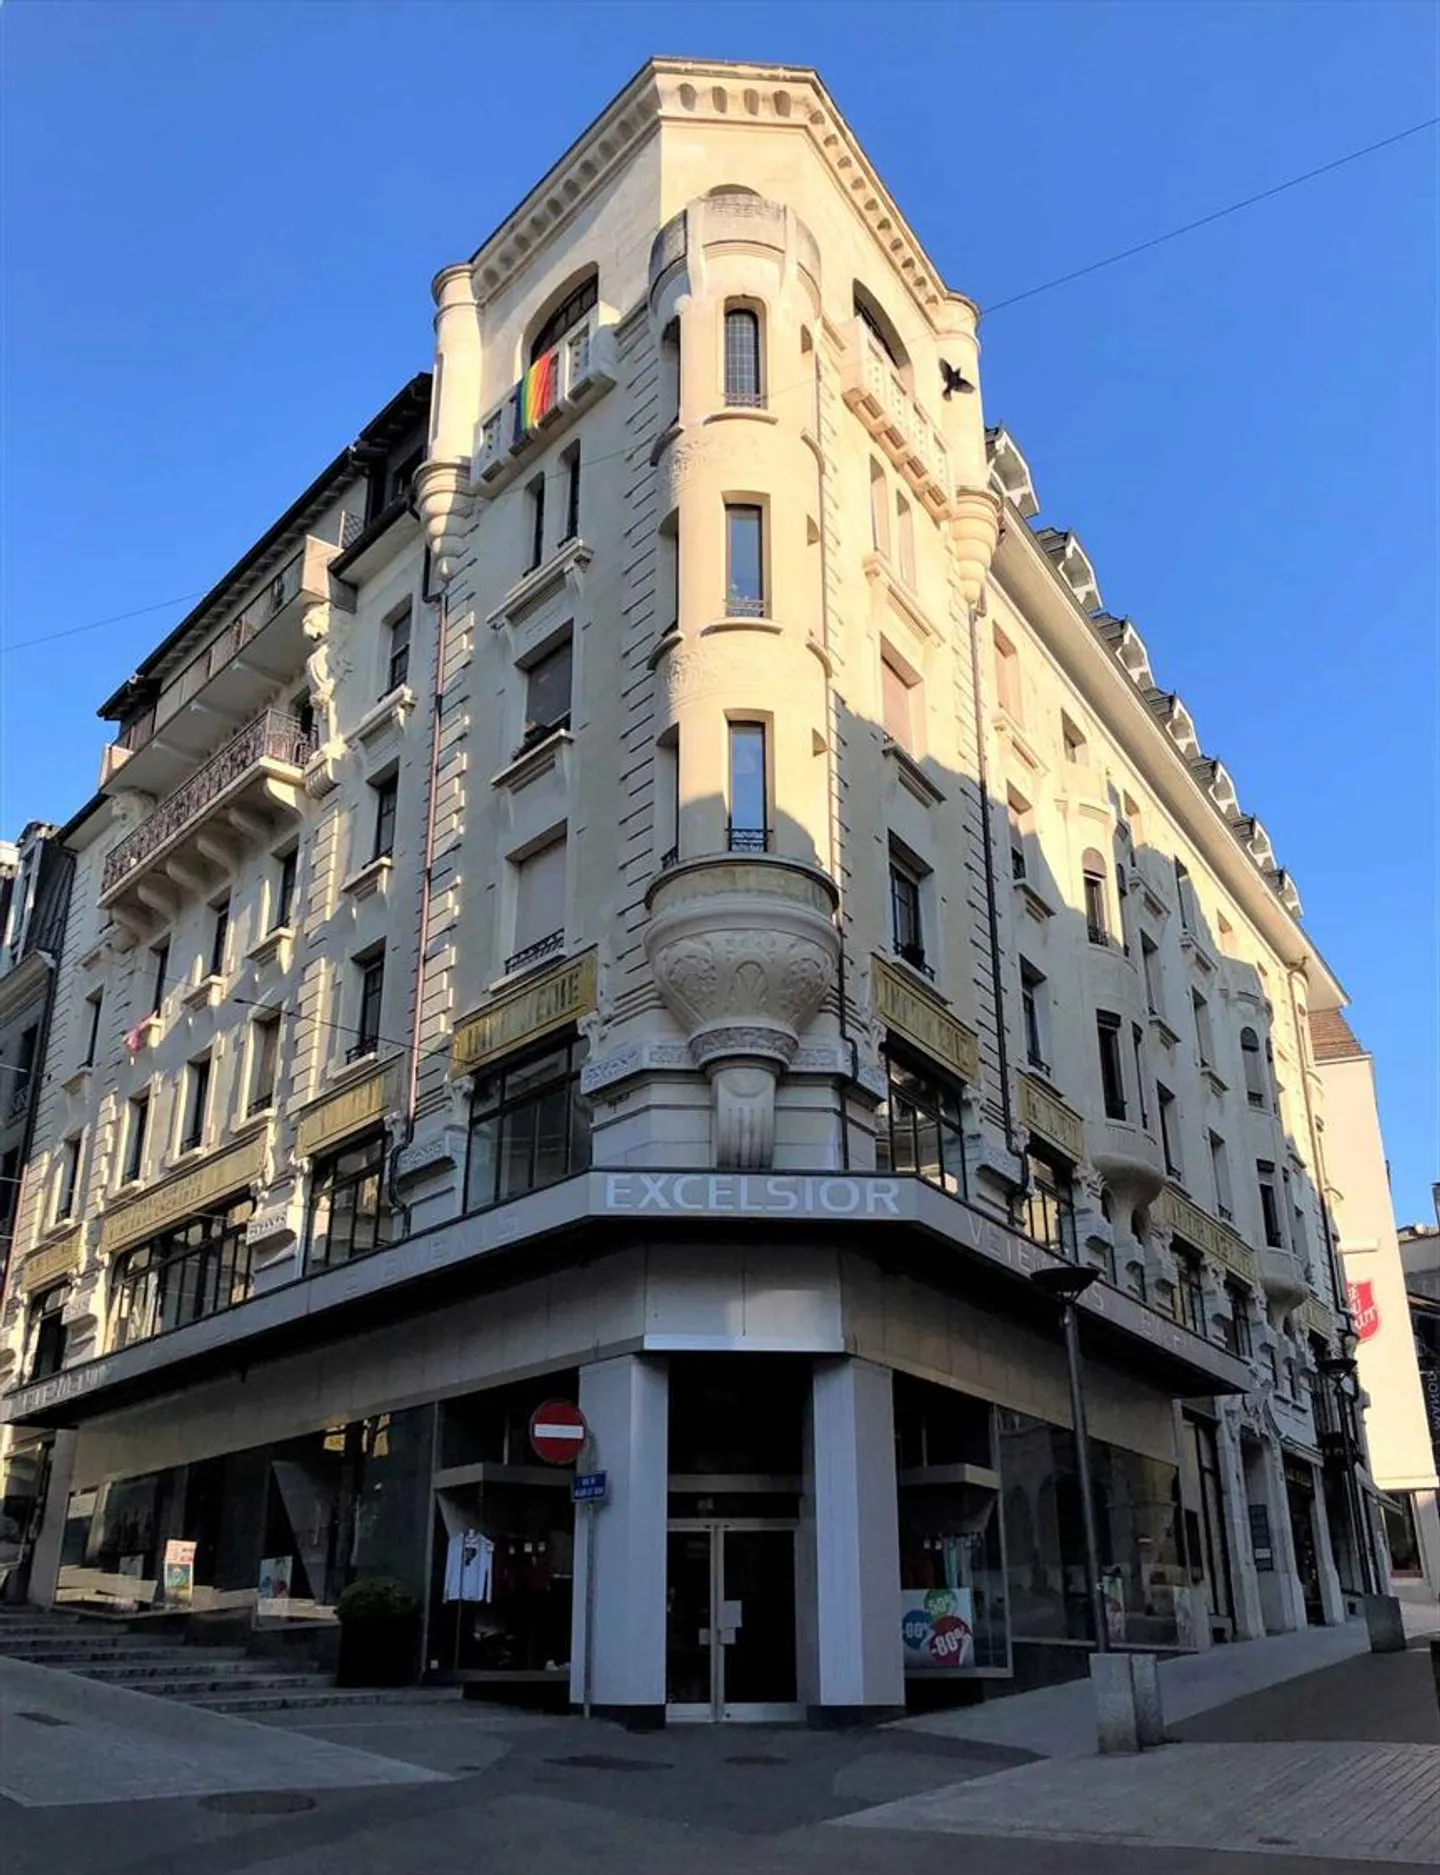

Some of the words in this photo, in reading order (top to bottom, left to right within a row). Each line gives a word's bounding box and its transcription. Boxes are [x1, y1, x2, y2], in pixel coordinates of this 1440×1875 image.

[606, 1173, 899, 1213] EXCELSIOR
[966, 1211, 1104, 1310] VETEMS
[930, 1625, 972, 1657] -80%
